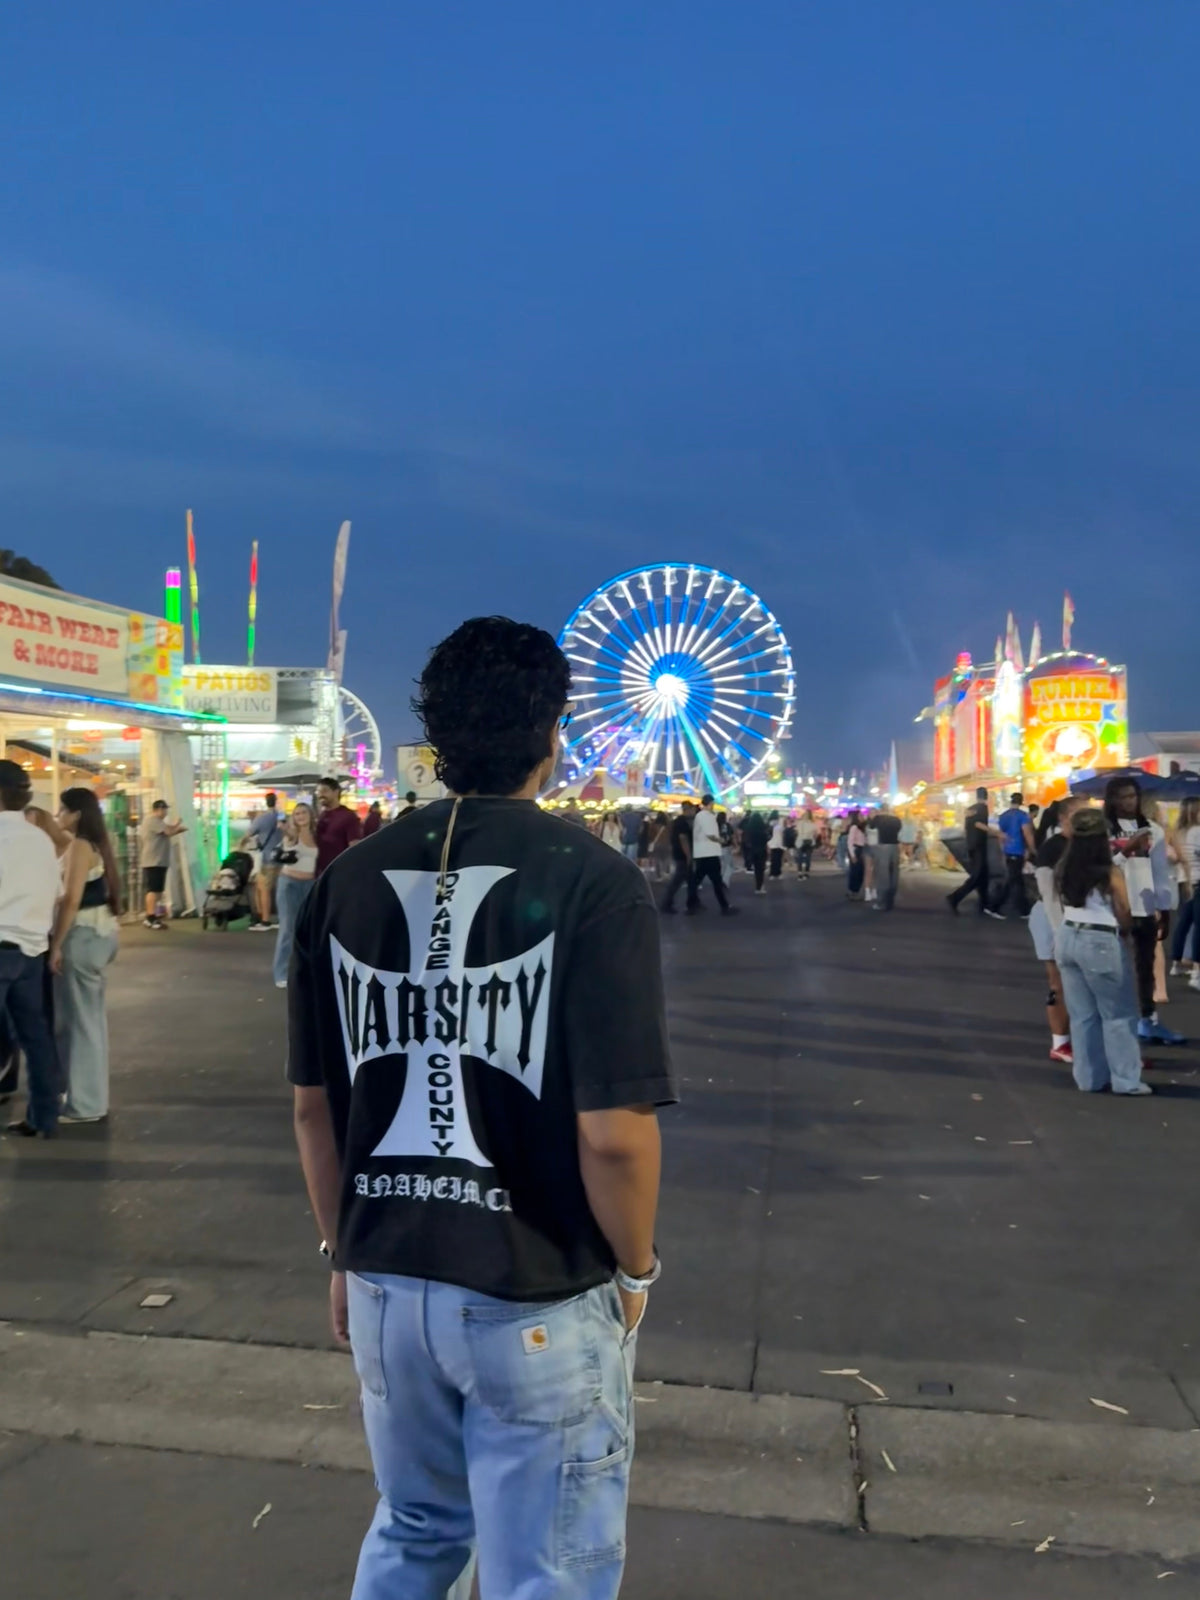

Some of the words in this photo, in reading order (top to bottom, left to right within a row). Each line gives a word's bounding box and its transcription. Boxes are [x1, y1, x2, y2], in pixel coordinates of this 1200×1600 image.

[13, 638, 30, 663] &
[35, 643, 99, 676] MORE
[195, 672, 271, 692] PATIOS
[217, 696, 272, 712] LIVING
[425, 872, 460, 971] ORANGE
[338, 953, 547, 1076] VARSITY
[427, 1053, 455, 1156] COUNTY
